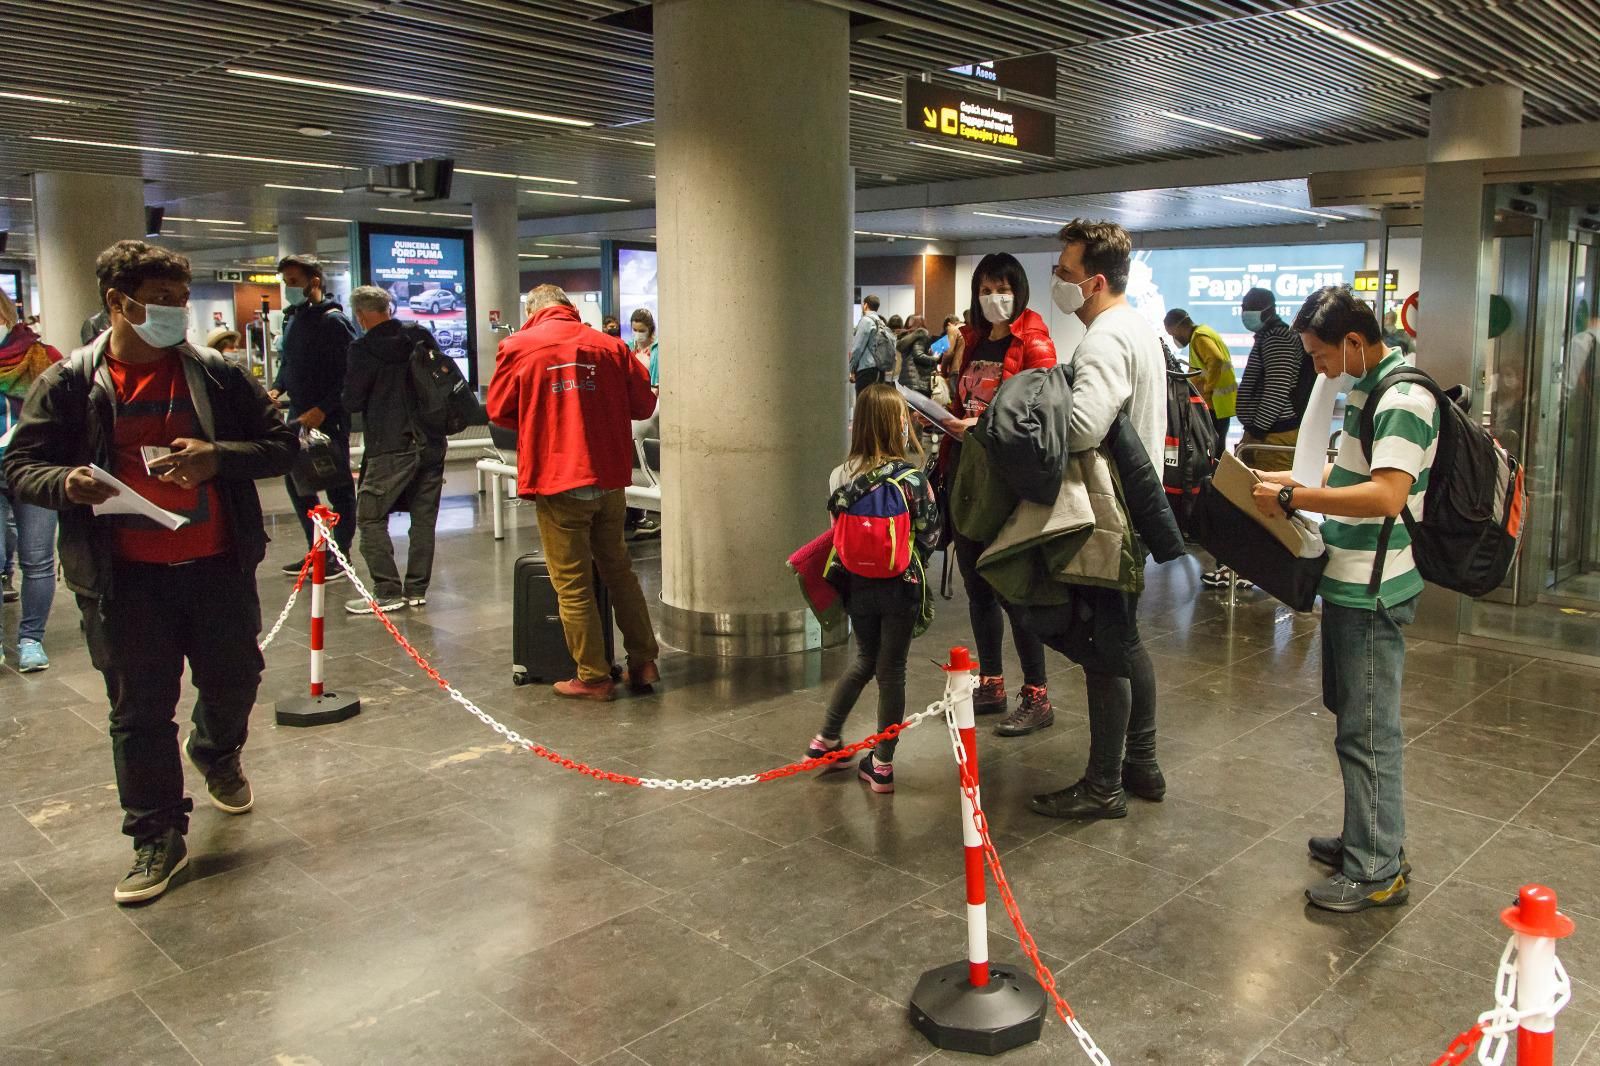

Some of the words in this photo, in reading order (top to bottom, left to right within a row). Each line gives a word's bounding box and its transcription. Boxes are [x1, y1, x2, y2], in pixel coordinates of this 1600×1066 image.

[976, 66, 996, 80] Aseos
[993, 133, 999, 144] y
[998, 133, 1017, 146] salida
[392, 248, 416, 257] FORD
[417, 250, 443, 259] PUMA
